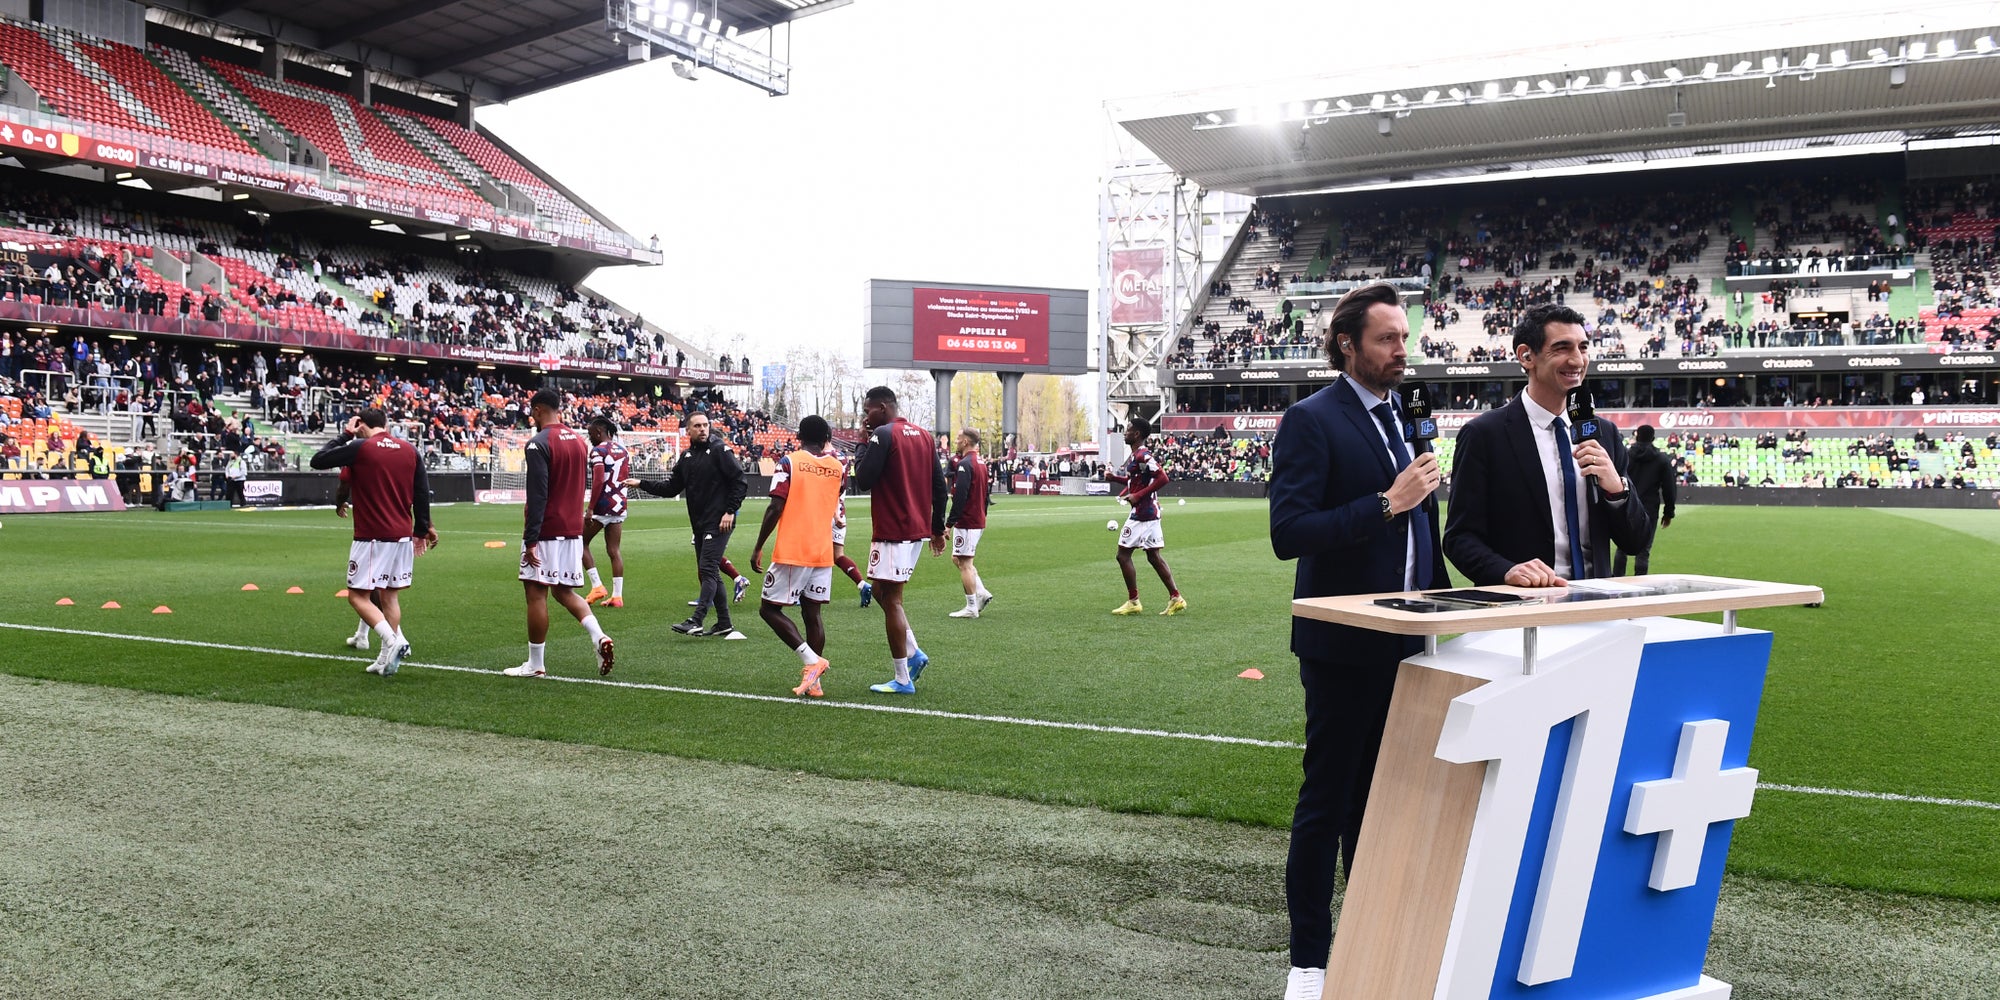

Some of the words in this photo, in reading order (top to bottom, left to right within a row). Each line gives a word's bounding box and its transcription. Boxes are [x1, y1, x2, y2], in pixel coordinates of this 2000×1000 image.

[96, 144, 135, 163] 00:00
[309, 186, 348, 203] Kappa
[391, 203, 413, 213] CLEAN
[959, 326, 996, 336] APPELEZ
[997, 328, 1007, 336] LE
[946, 338, 960, 348] 06
[961, 339, 975, 349] 45
[976, 339, 990, 349] 03
[991, 340, 1002, 349] 13
[1003, 340, 1017, 350] 06
[450, 346, 459, 356] Le
[1248, 417, 1277, 429] uem
[1936, 411, 2000, 425] INTERSP
[799, 462, 840, 478] Kappa
